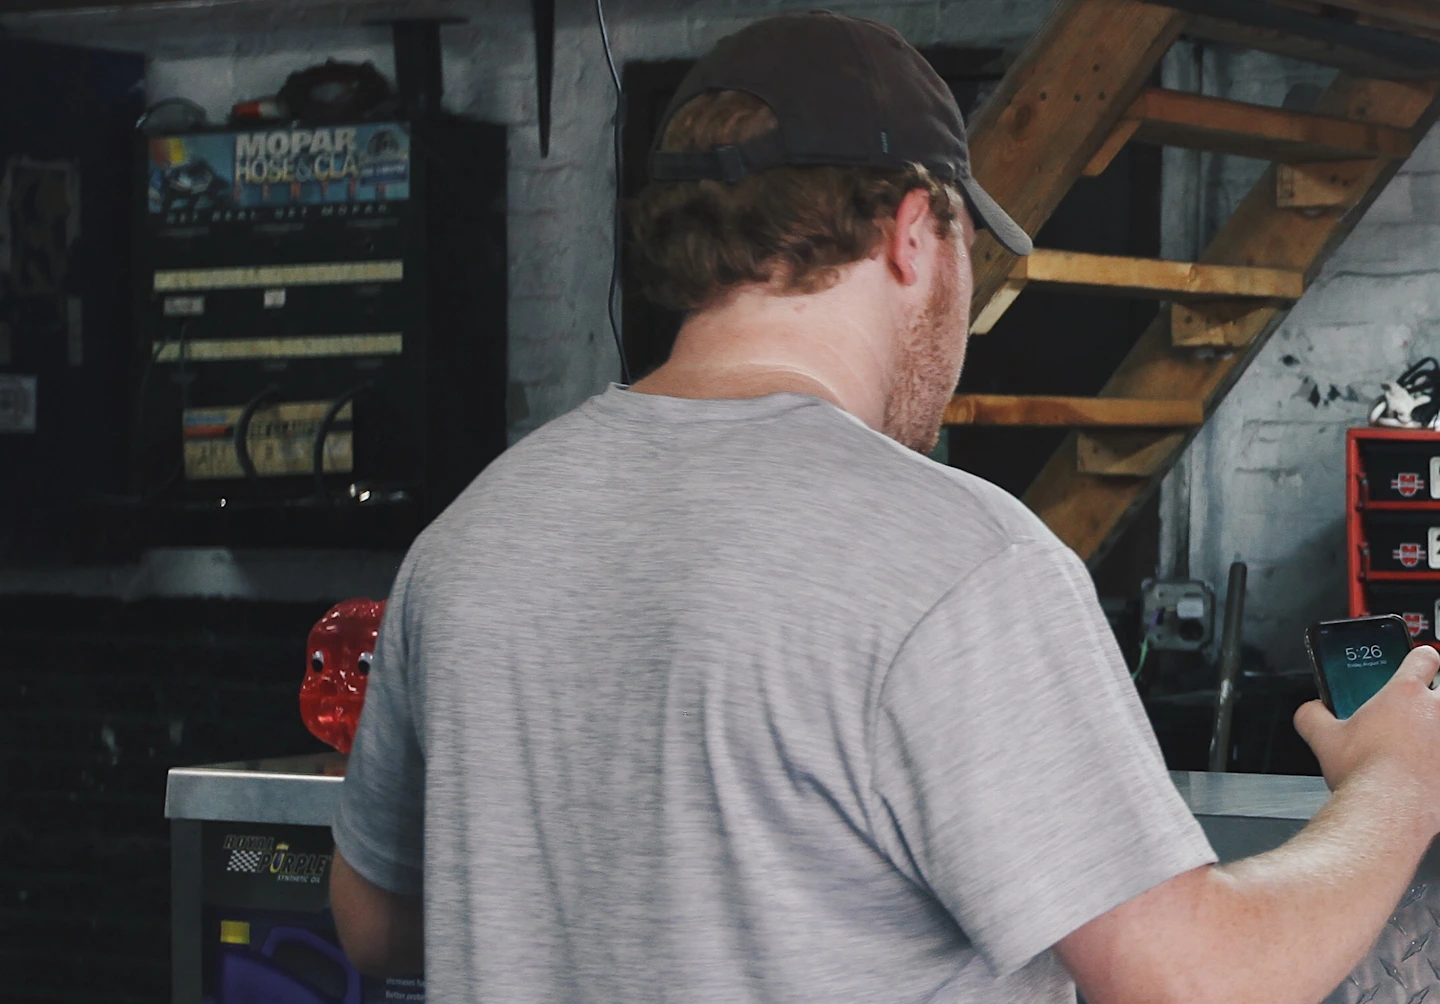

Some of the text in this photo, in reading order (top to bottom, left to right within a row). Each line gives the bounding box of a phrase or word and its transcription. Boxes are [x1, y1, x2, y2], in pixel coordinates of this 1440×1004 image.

[236, 127, 358, 157] MOPAR
[1345, 644, 1383, 661] 5:26
[223, 834, 275, 850] ROYAL
[256, 851, 328, 876] PURPLE
[276, 874, 309, 883] SYNTHETIC
